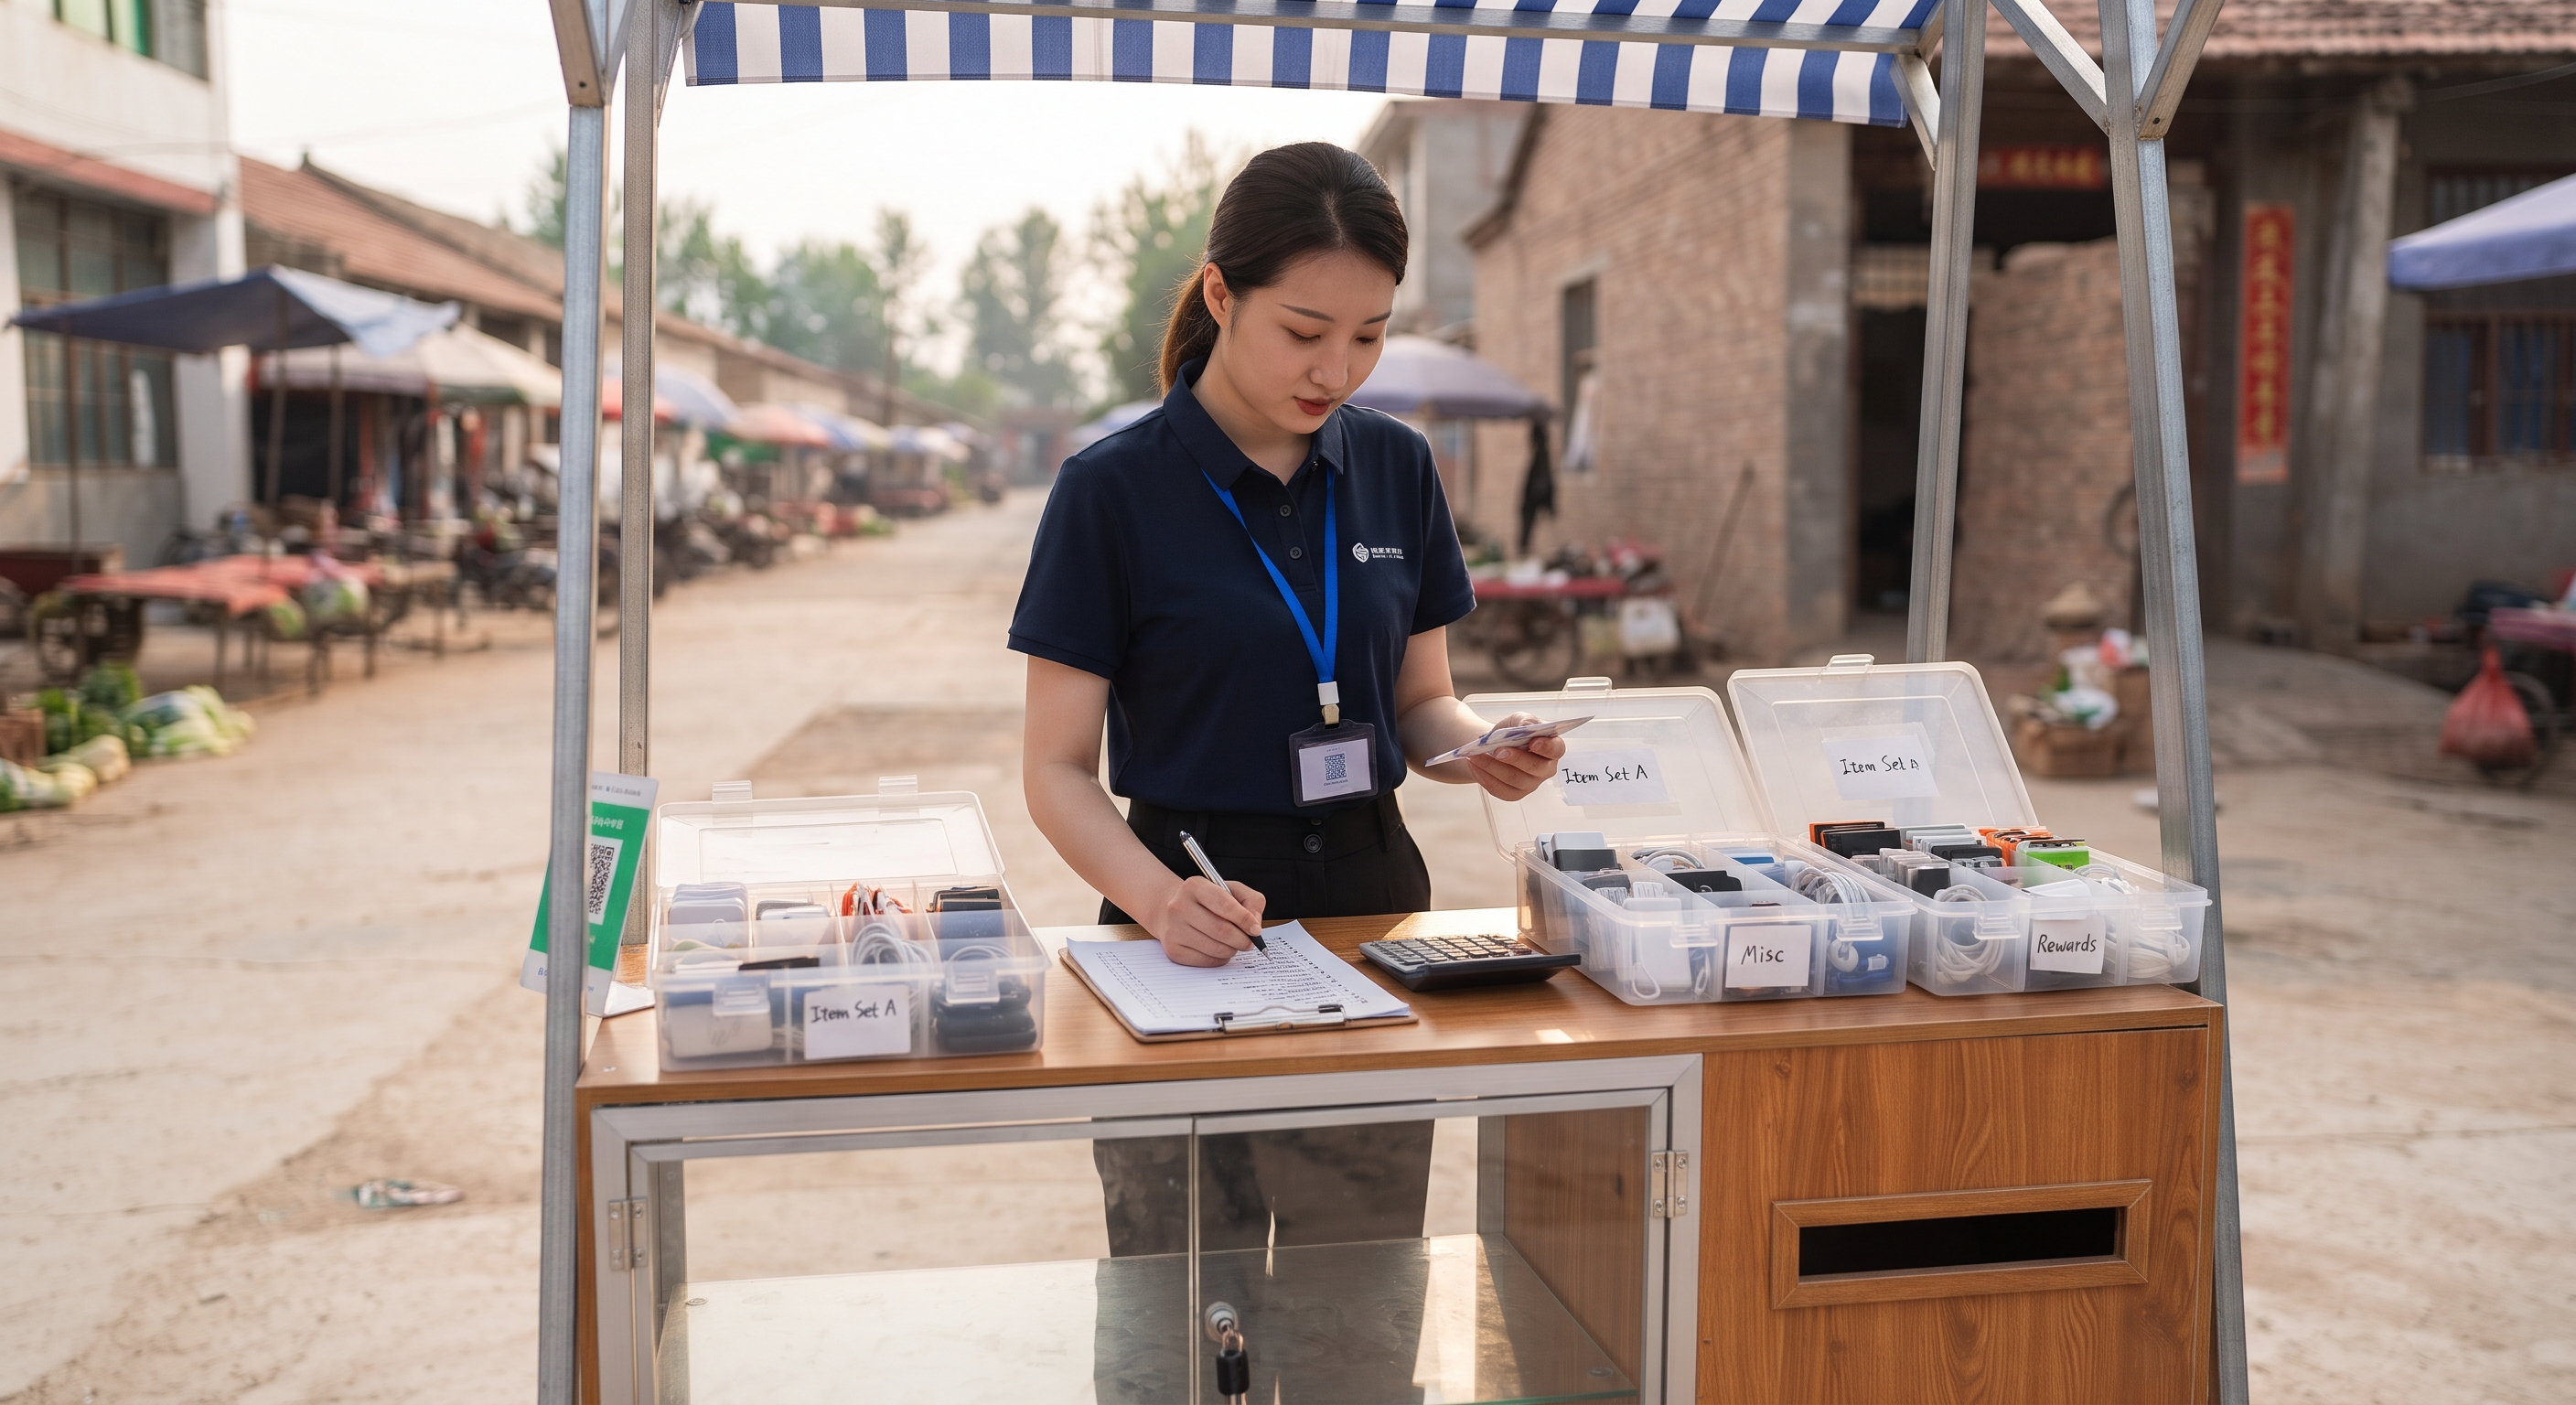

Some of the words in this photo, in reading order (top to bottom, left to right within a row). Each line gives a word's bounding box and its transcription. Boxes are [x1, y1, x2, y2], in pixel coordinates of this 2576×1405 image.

[1562, 767, 1599, 785] Item
[1605, 766, 1630, 783] Set
[1636, 764, 1648, 780] A
[1839, 758, 1877, 776] Item
[2036, 933, 2098, 954] Rewards
[1740, 945, 1785, 966] Misc
[810, 1005, 850, 1024] Item
[854, 1000, 880, 1019] Set
[885, 998, 897, 1016] A
